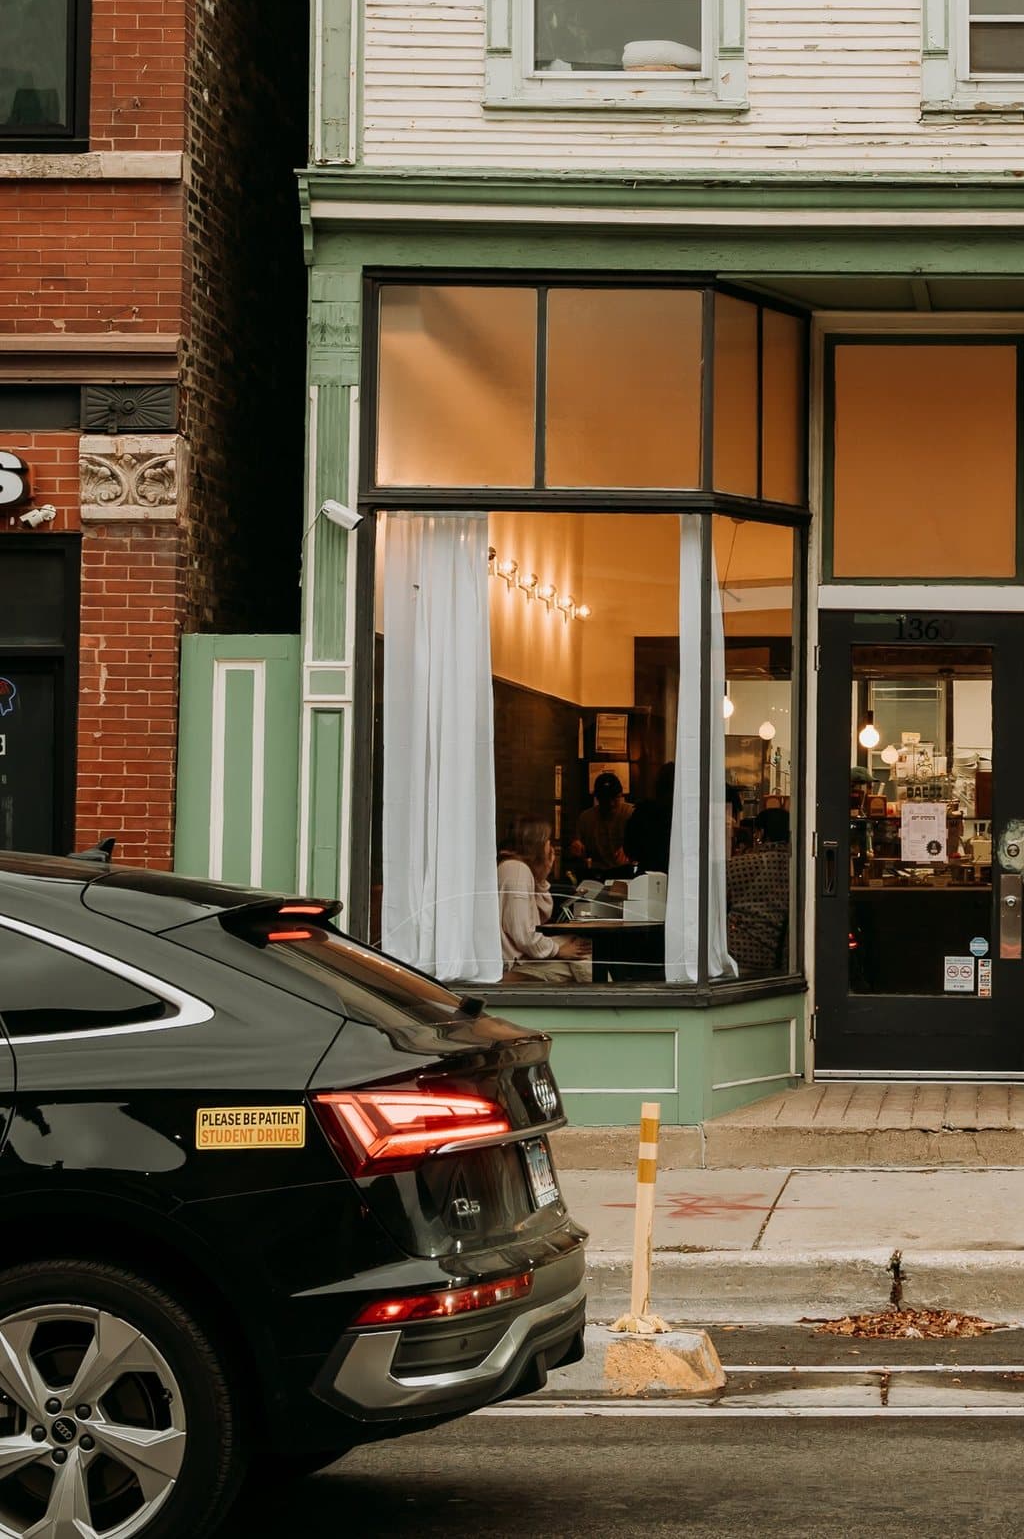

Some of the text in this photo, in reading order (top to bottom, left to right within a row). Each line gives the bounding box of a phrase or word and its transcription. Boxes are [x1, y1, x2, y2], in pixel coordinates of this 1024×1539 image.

[201, 1111, 300, 1126] PLEASE BE PATIENT
[201, 1127, 300, 1143] STUDENT DRIVER
[452, 1198, 480, 1215] Q5
